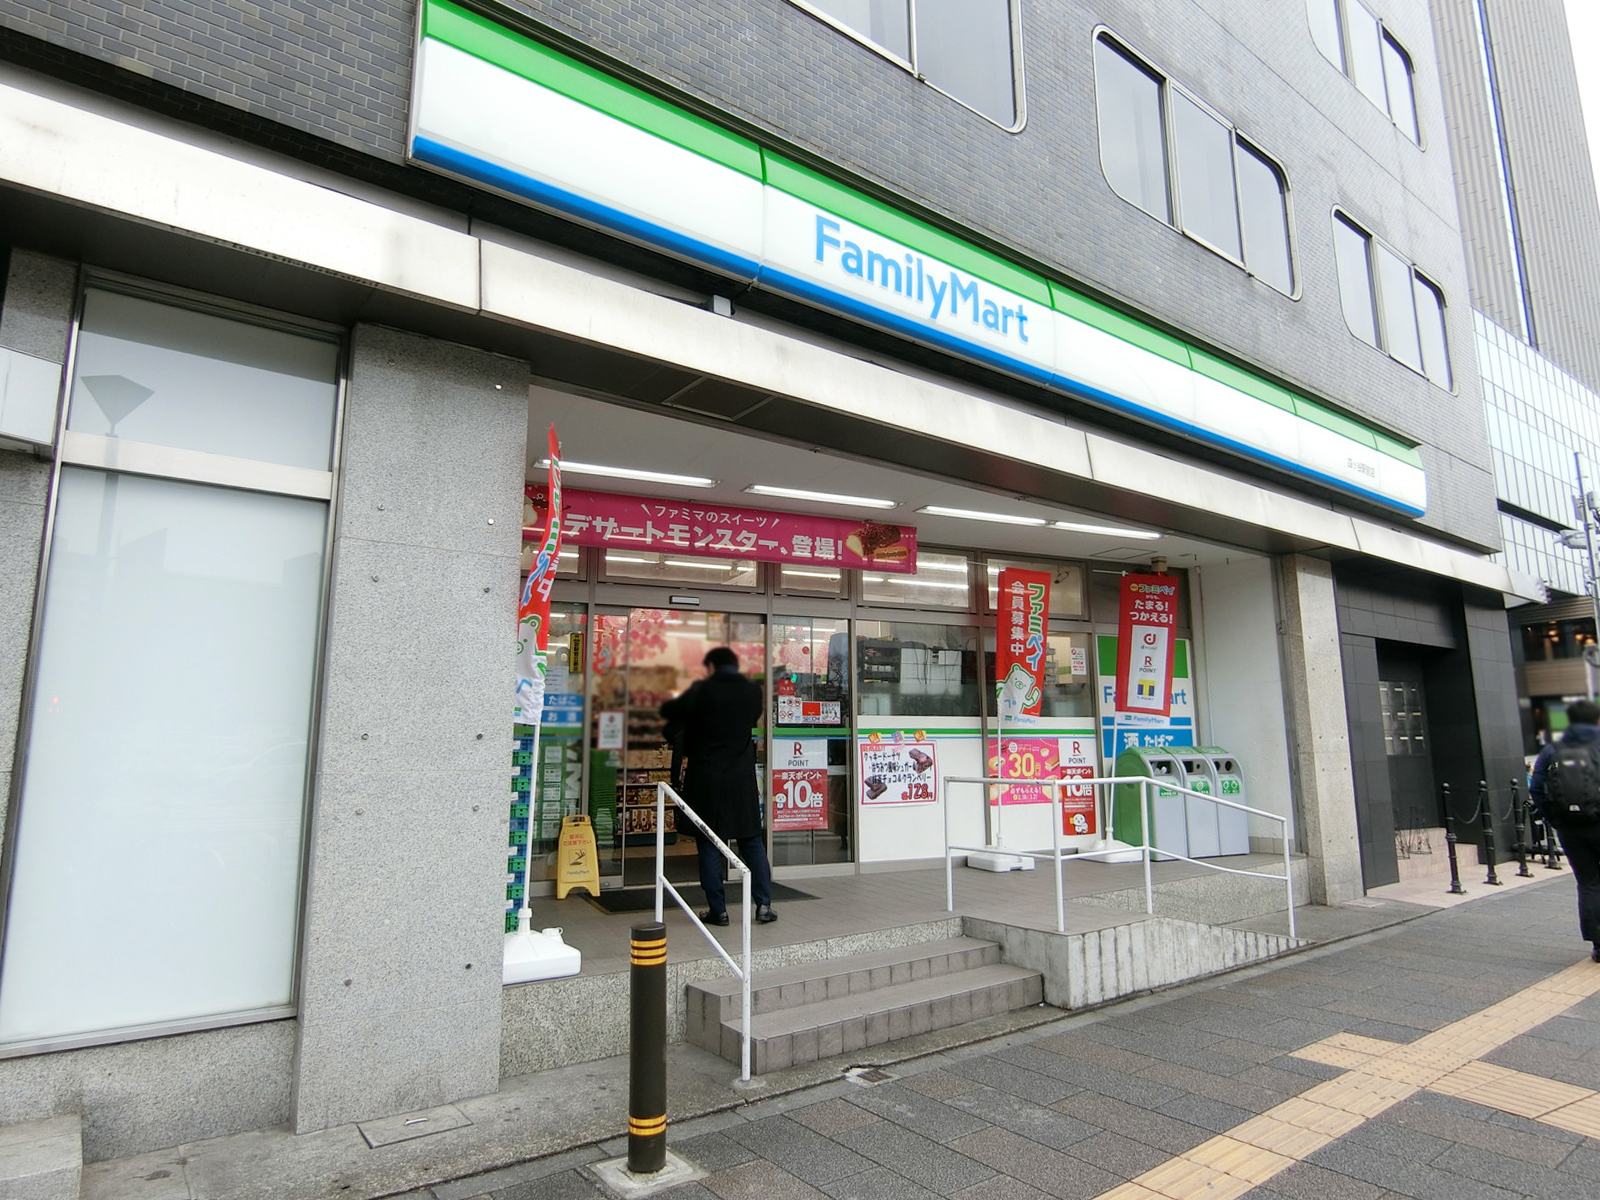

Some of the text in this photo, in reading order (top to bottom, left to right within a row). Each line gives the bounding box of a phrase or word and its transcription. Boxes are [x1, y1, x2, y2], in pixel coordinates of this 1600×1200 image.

[815, 214, 1029, 343] FamilyMart
[654, 505, 768, 528] ファミマのスイーツ
[1138, 583, 1175, 596] ファミペイ
[1134, 600, 1169, 612] たまる!
[1010, 580, 1025, 657] 会員募集中
[1129, 611, 1173, 624] つかえる!
[1026, 583, 1045, 672] ファミペイ
[1144, 656, 1152, 666] R
[1133, 715, 1164, 725] FamilyMart
[794, 742, 802, 755] R
[1072, 741, 1081, 753] R
[788, 759, 809, 767] POINT
[783, 780, 824, 809] 10倍
